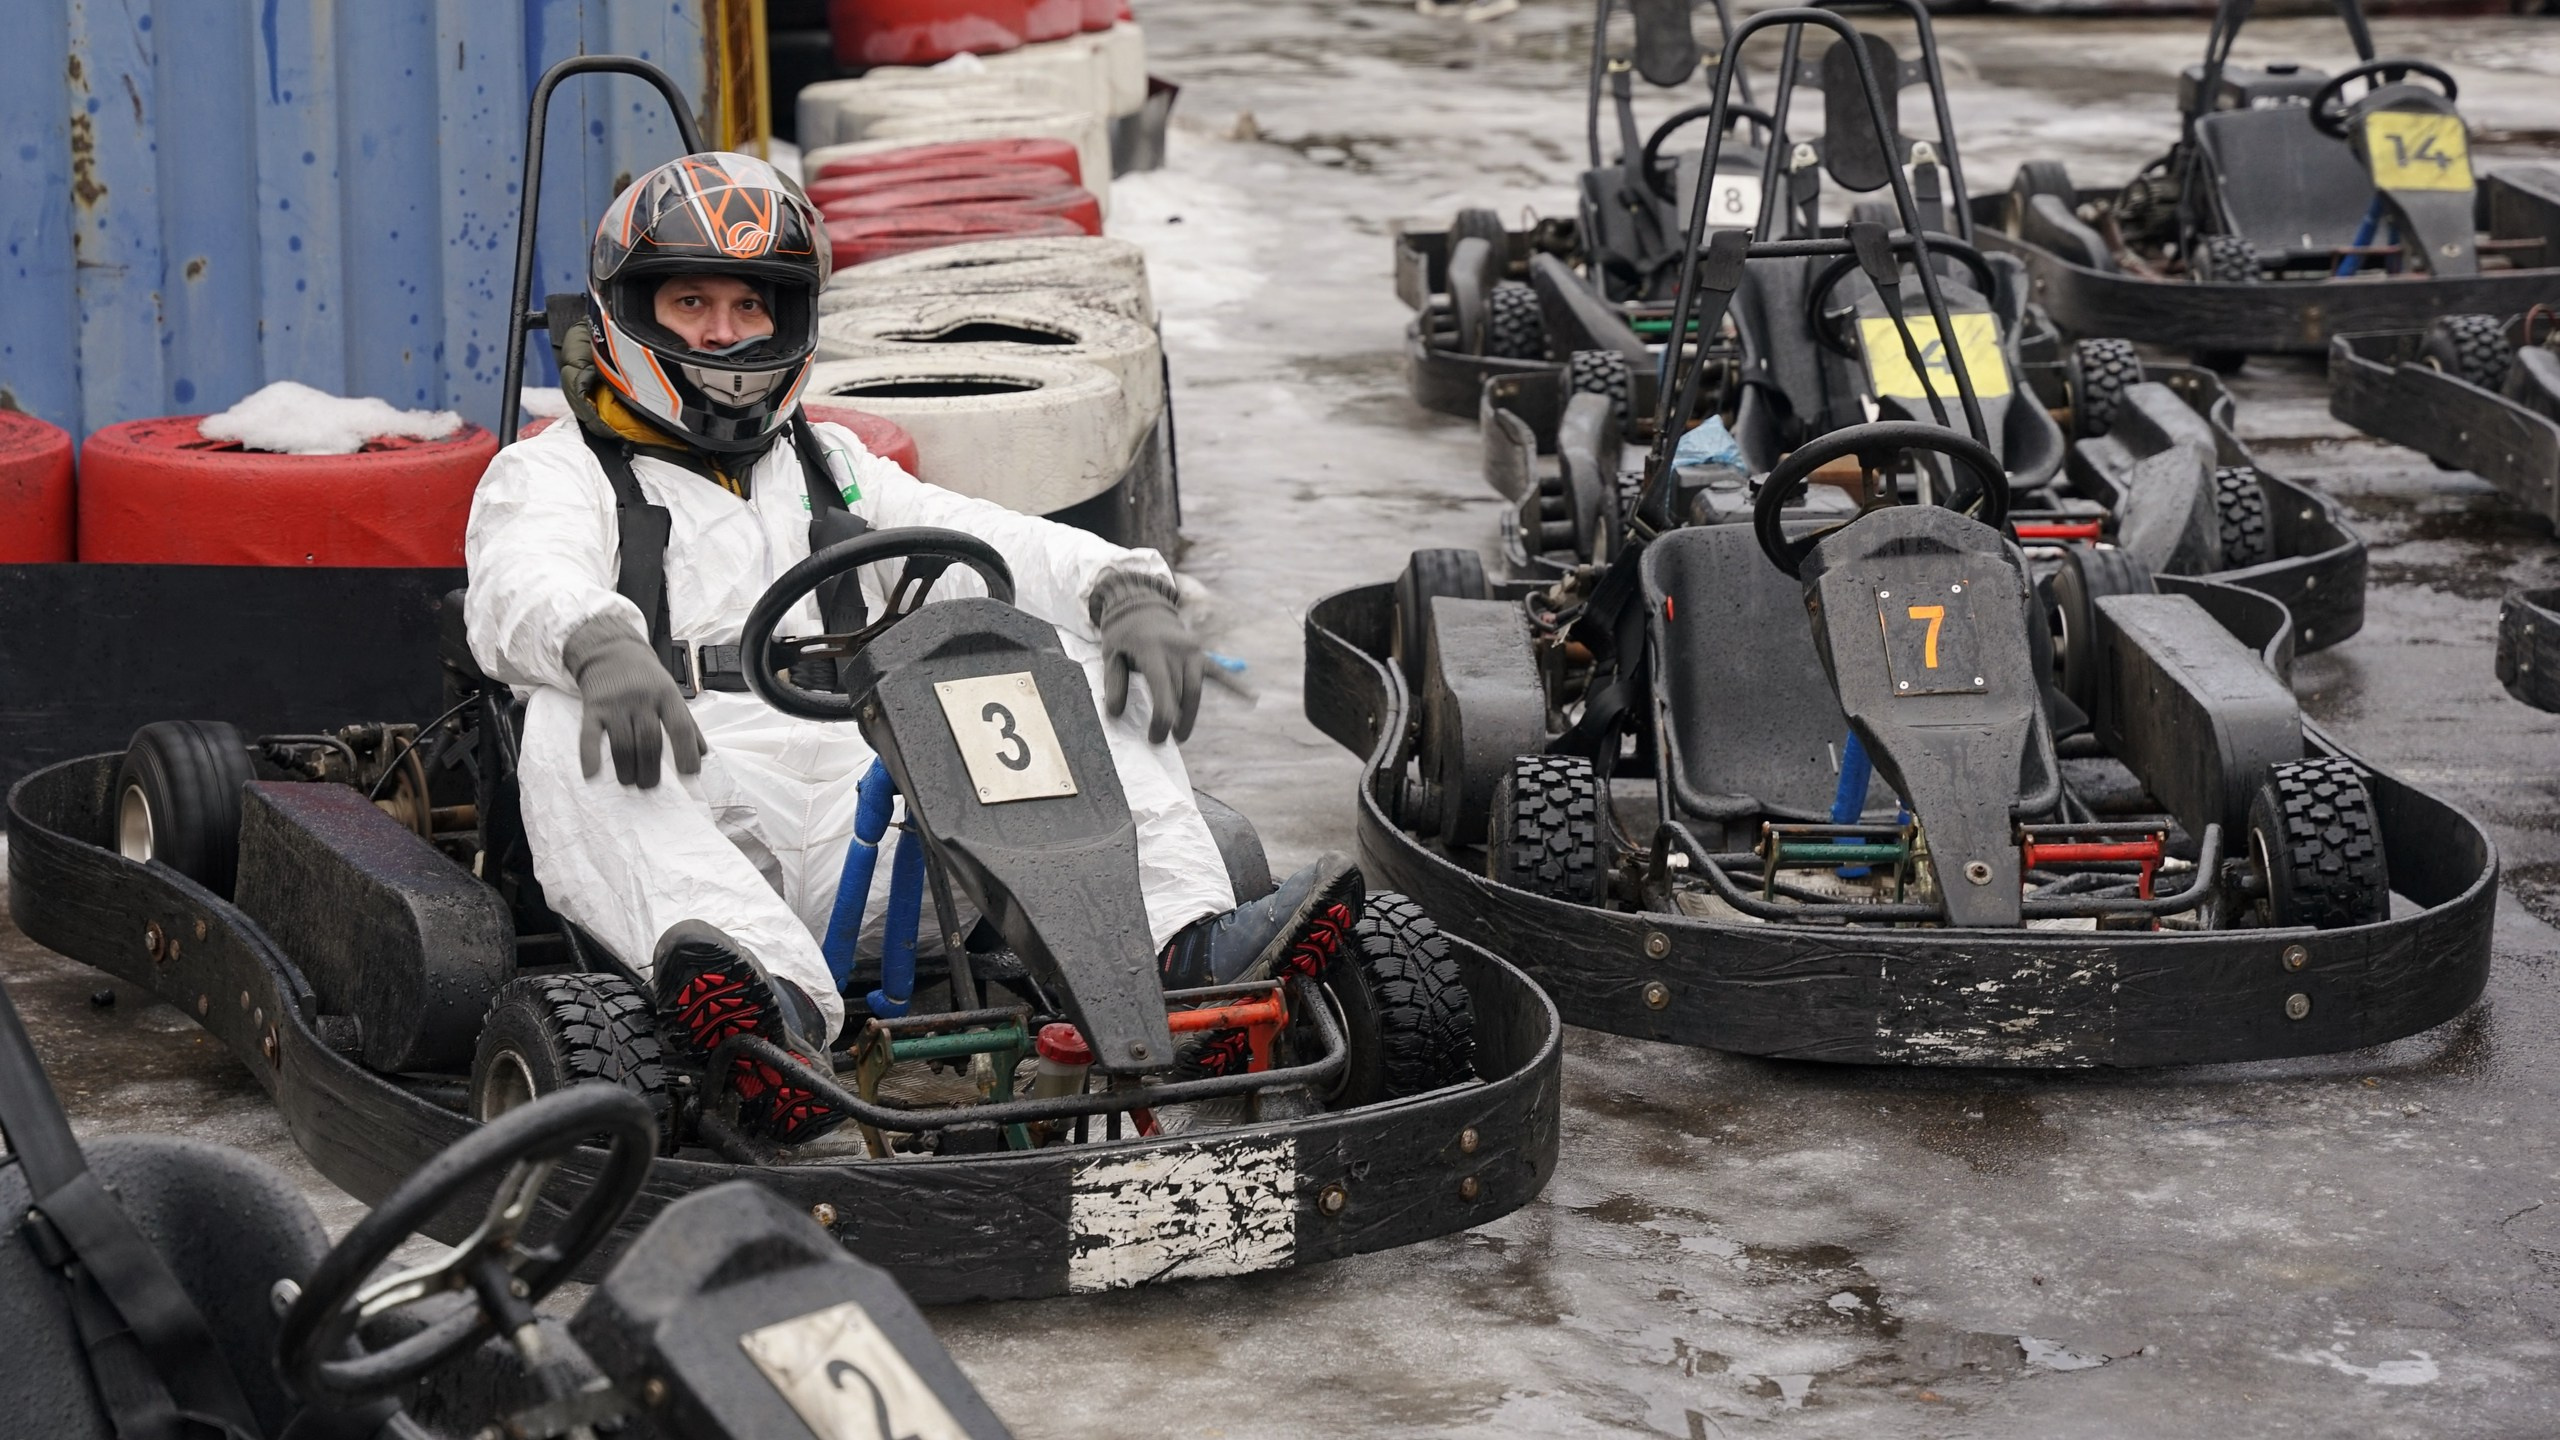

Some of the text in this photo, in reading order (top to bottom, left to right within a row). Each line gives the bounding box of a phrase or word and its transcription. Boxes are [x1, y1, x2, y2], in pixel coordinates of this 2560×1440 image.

[2384, 134, 2453, 168] 14
[1725, 187, 1743, 213] 8
[1919, 339, 1956, 375] 4
[1908, 605, 1944, 668] 7
[982, 702, 1031, 771] 3
[827, 1360, 922, 1440] 2
